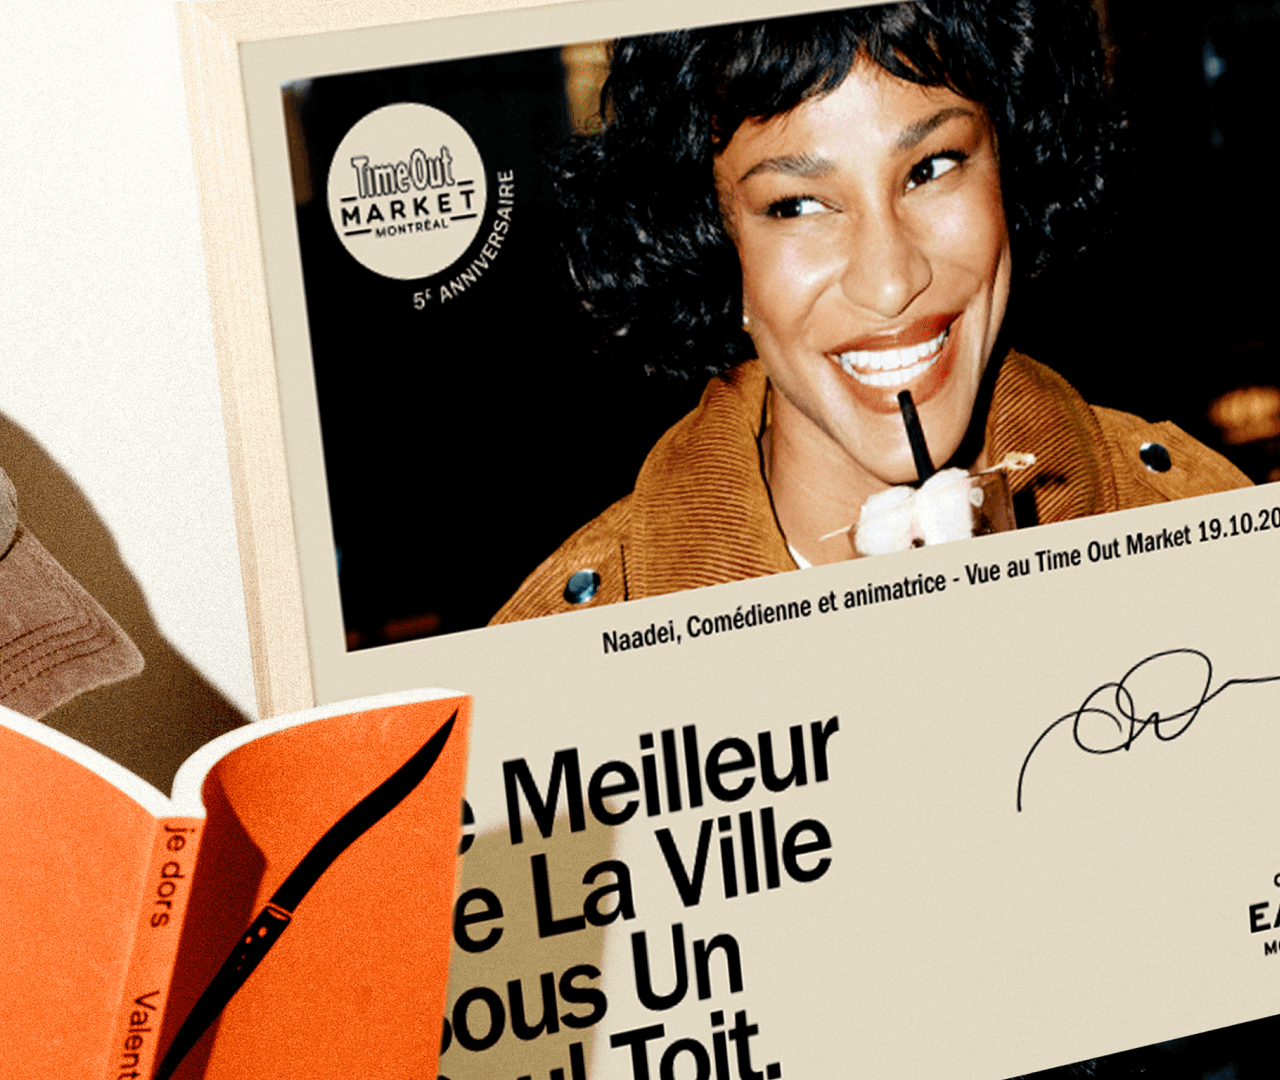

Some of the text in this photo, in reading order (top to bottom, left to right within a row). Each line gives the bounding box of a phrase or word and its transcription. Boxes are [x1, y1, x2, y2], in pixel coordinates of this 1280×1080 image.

[340, 190, 475, 226] MARKET
[375, 218, 449, 238] MONTRÉAL
[439, 169, 515, 304] ANNIVERSAIRE
[602, 507, 1280, 655] Naadei, Comédienne et animatrice Vue au Time Out Market 19.10.20
[164, 825, 195, 852] je
[503, 716, 840, 845] Meilleur
[149, 861, 186, 929] dors
[530, 806, 833, 939] La Ville
[439, 922, 744, 1056] ous Un
